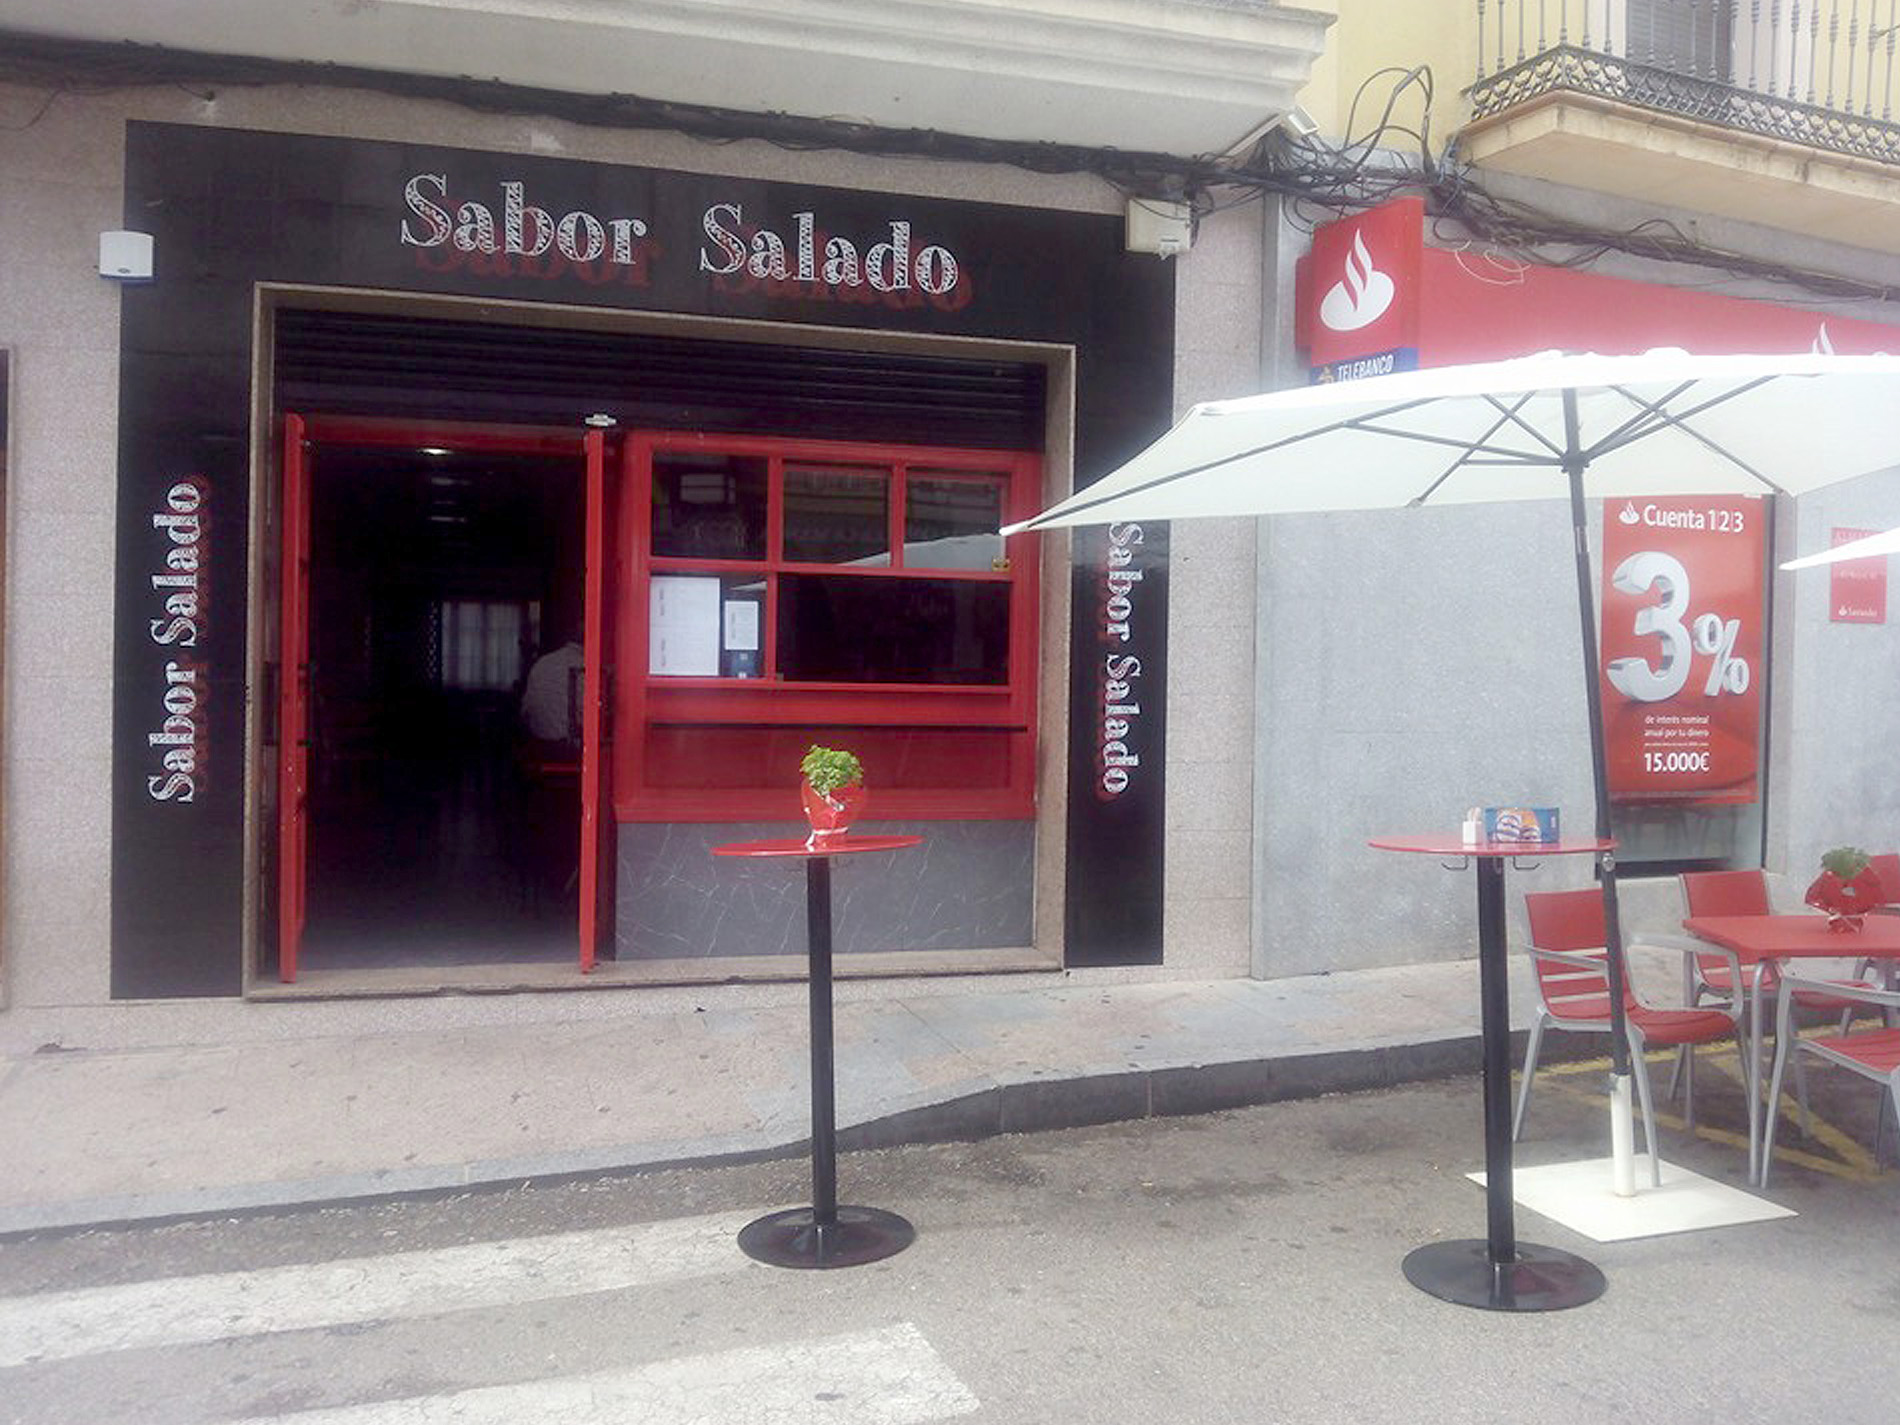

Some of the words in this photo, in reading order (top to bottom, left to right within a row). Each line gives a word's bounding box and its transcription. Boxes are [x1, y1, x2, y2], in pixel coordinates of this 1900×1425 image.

[400, 173, 648, 266] Sabor
[699, 203, 960, 296] Salado
[1338, 354, 1394, 382] TELEBANCO
[150, 482, 201, 647] Salado
[1643, 504, 1705, 530] Cuenta
[1106, 521, 1145, 642] Sabor
[1606, 551, 1750, 702] 3%
[148, 660, 197, 803] Sabor
[1102, 654, 1141, 794] Salado
[1644, 715, 1654, 725] de
[1681, 715, 1710, 724] nominal
[1644, 728, 1664, 737] anual
[1665, 730, 1677, 739] por
[1686, 728, 1710, 737] dinero
[1644, 752, 1710, 773] 15.000€
